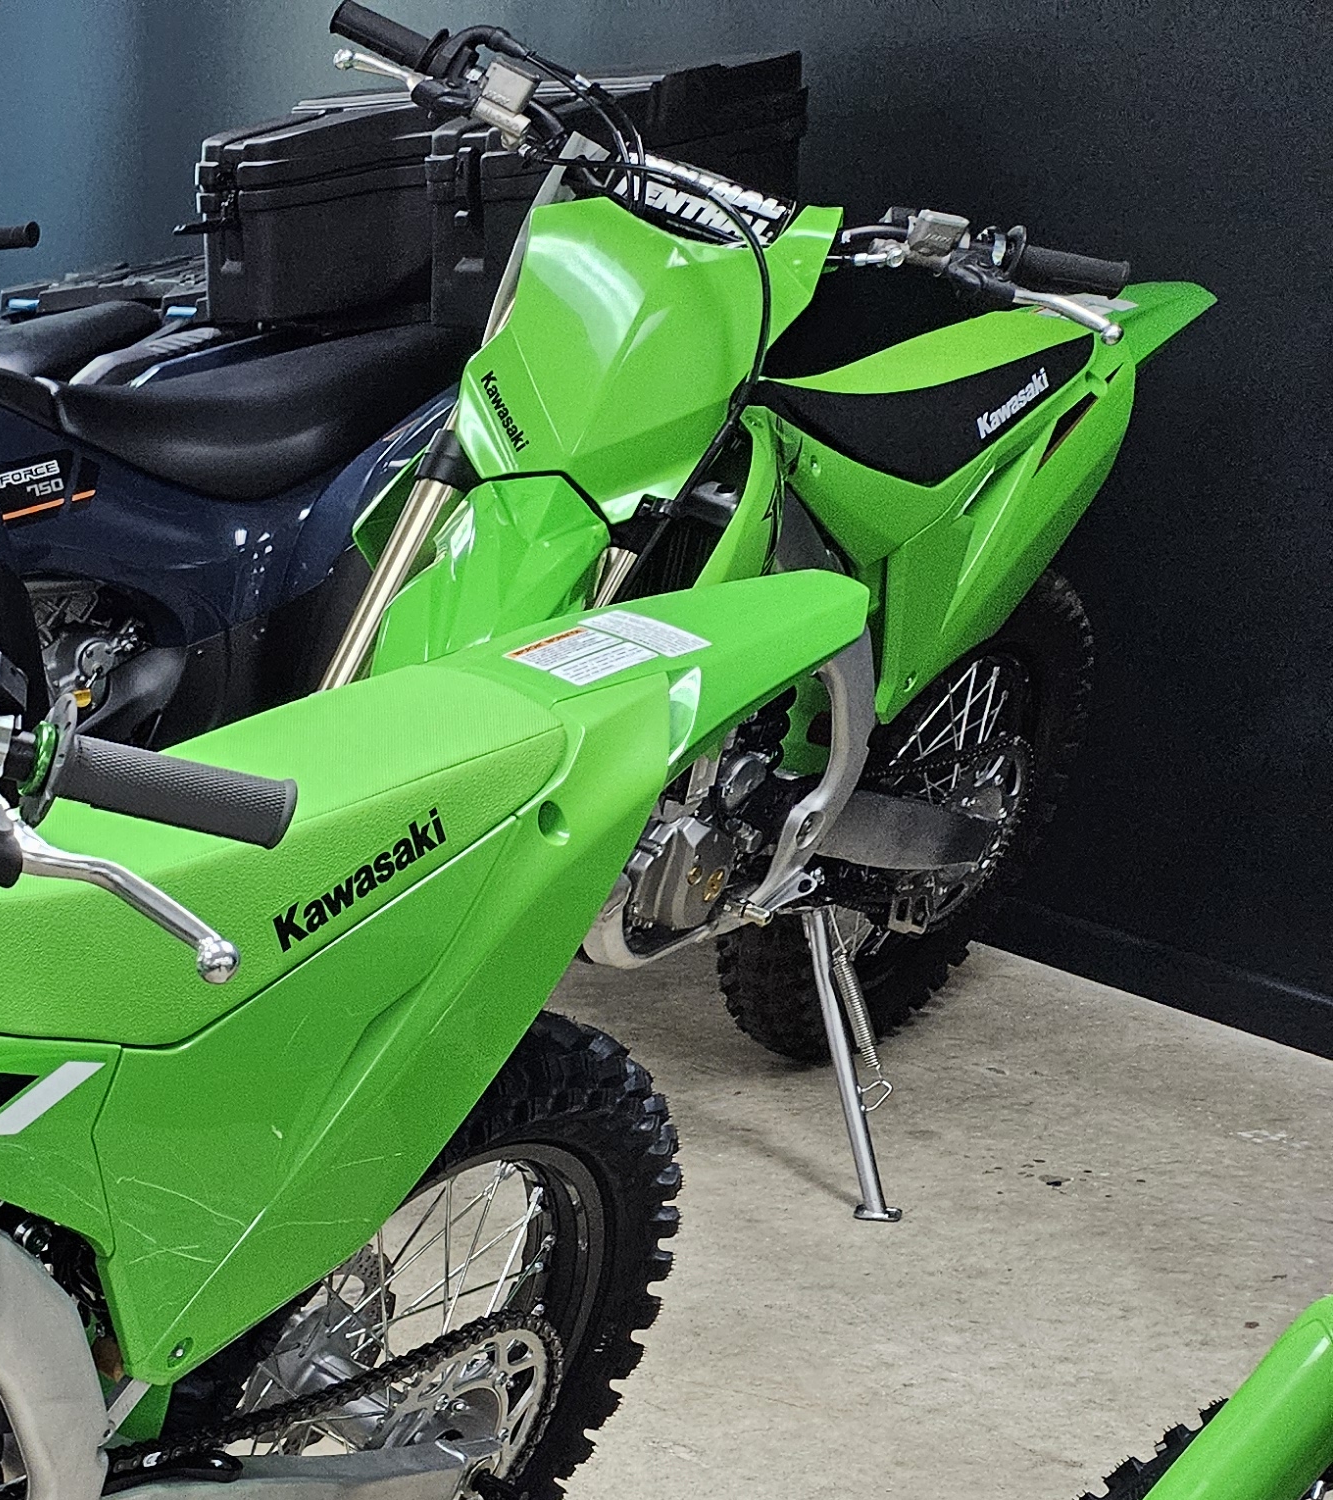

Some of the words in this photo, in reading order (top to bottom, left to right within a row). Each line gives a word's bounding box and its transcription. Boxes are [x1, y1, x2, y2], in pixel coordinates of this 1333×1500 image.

[480, 370, 529, 452] Kawasaki
[976, 366, 1050, 440] Kawasaki
[26, 477, 65, 498] 750
[272, 807, 447, 953] Kawasaki
